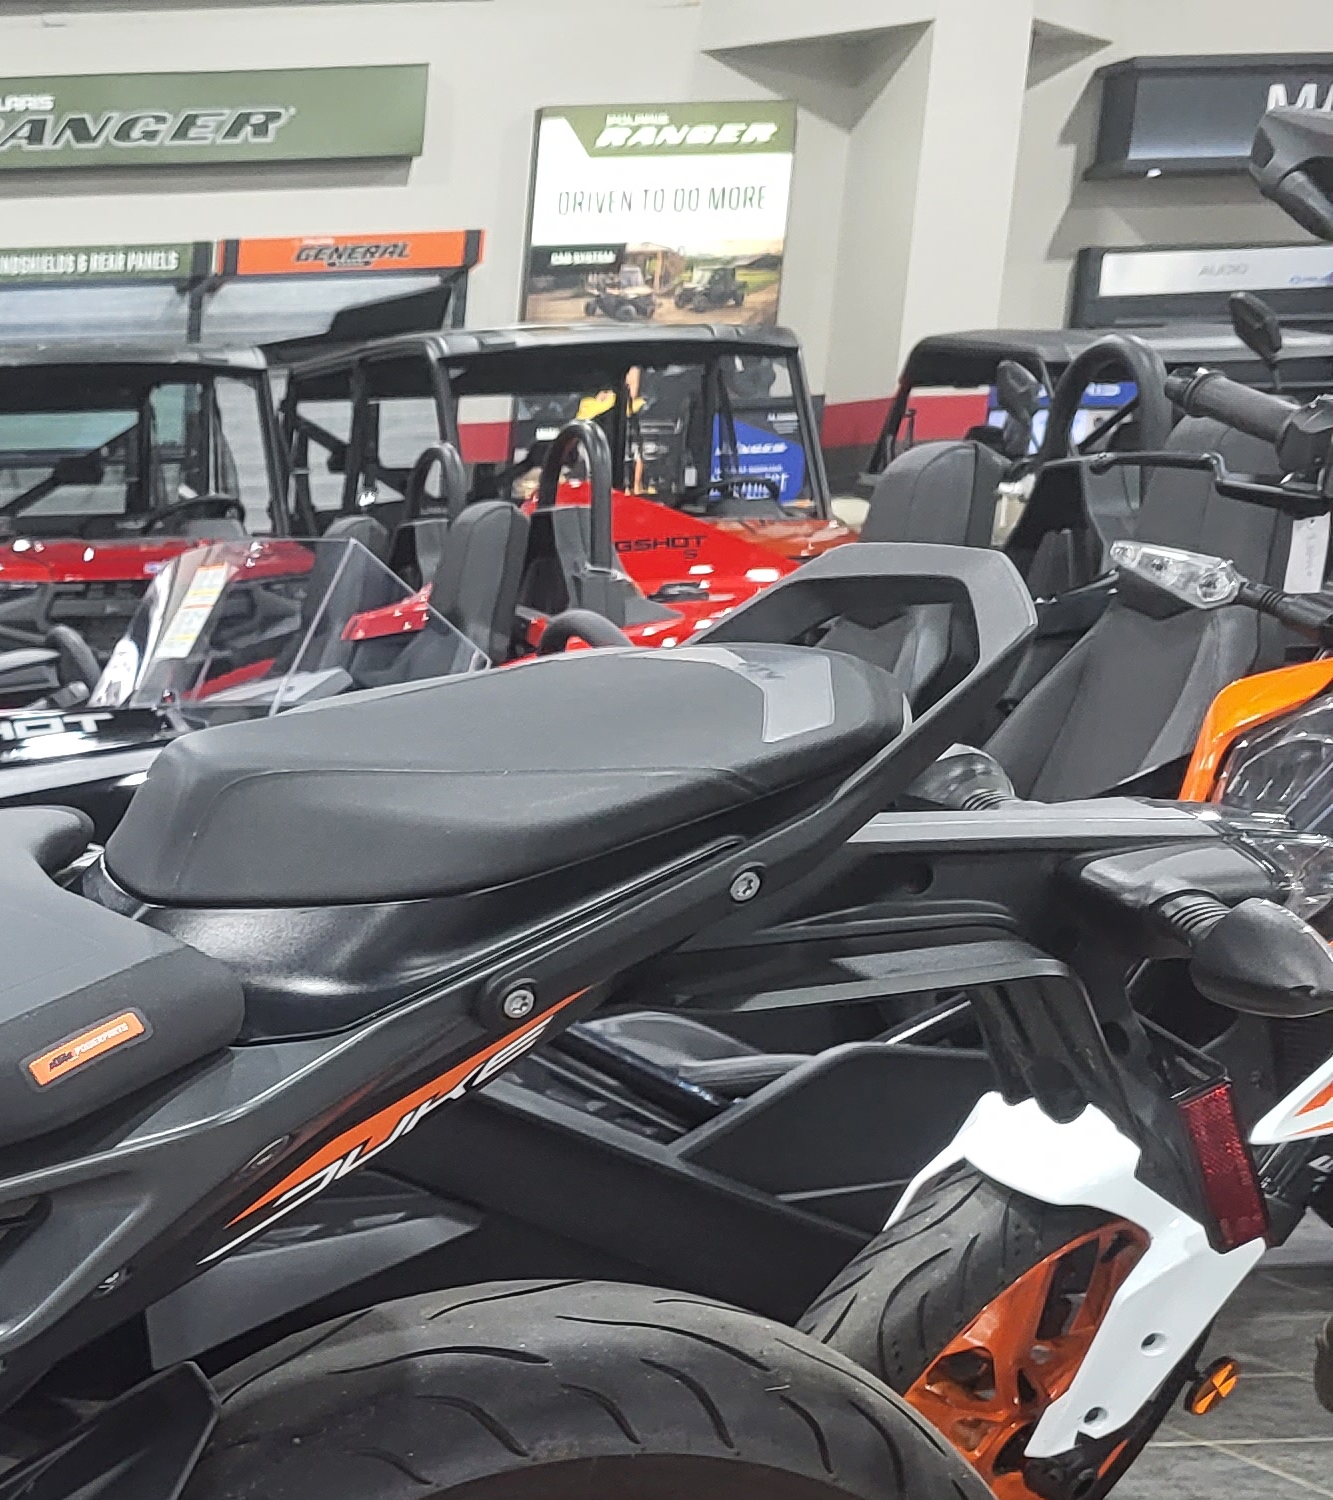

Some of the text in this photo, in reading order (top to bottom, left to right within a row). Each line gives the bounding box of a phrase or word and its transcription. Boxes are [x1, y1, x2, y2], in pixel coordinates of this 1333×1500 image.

[594, 122, 778, 148] RANGER
[558, 185, 767, 215] DRIVEN TO DO MORE
[89, 253, 126, 273] REAR
[127, 250, 179, 272] PANELS
[295, 242, 410, 263] GENERAL
